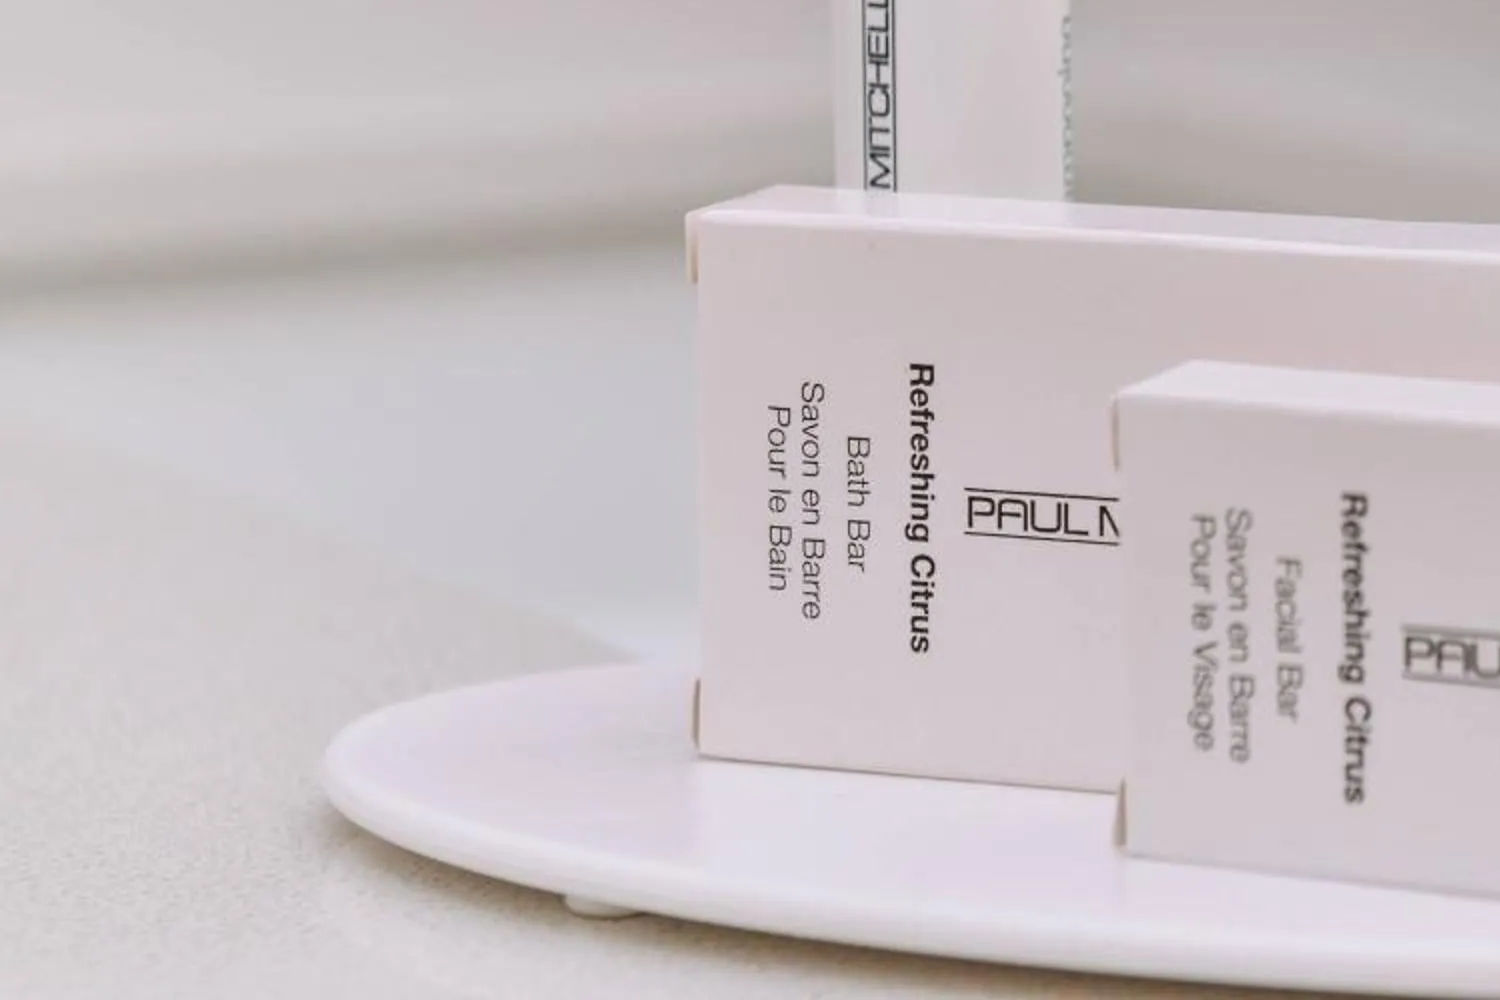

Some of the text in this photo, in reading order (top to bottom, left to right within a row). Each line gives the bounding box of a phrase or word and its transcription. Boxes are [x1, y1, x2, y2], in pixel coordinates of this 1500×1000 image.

[768, 406, 792, 590] Pour le Bain
[801, 382, 825, 619] Savon en Barre
[847, 436, 870, 572] Bath Bar
[904, 364, 935, 653] Refreshing Citrus
[966, 495, 1089, 537] PAUL
[1187, 514, 1218, 751] Pour le Visage
[1225, 508, 1255, 763] Savon en Barre
[1275, 557, 1304, 720] Facial Bar
[1338, 493, 1372, 803] Refreshing Citrus
